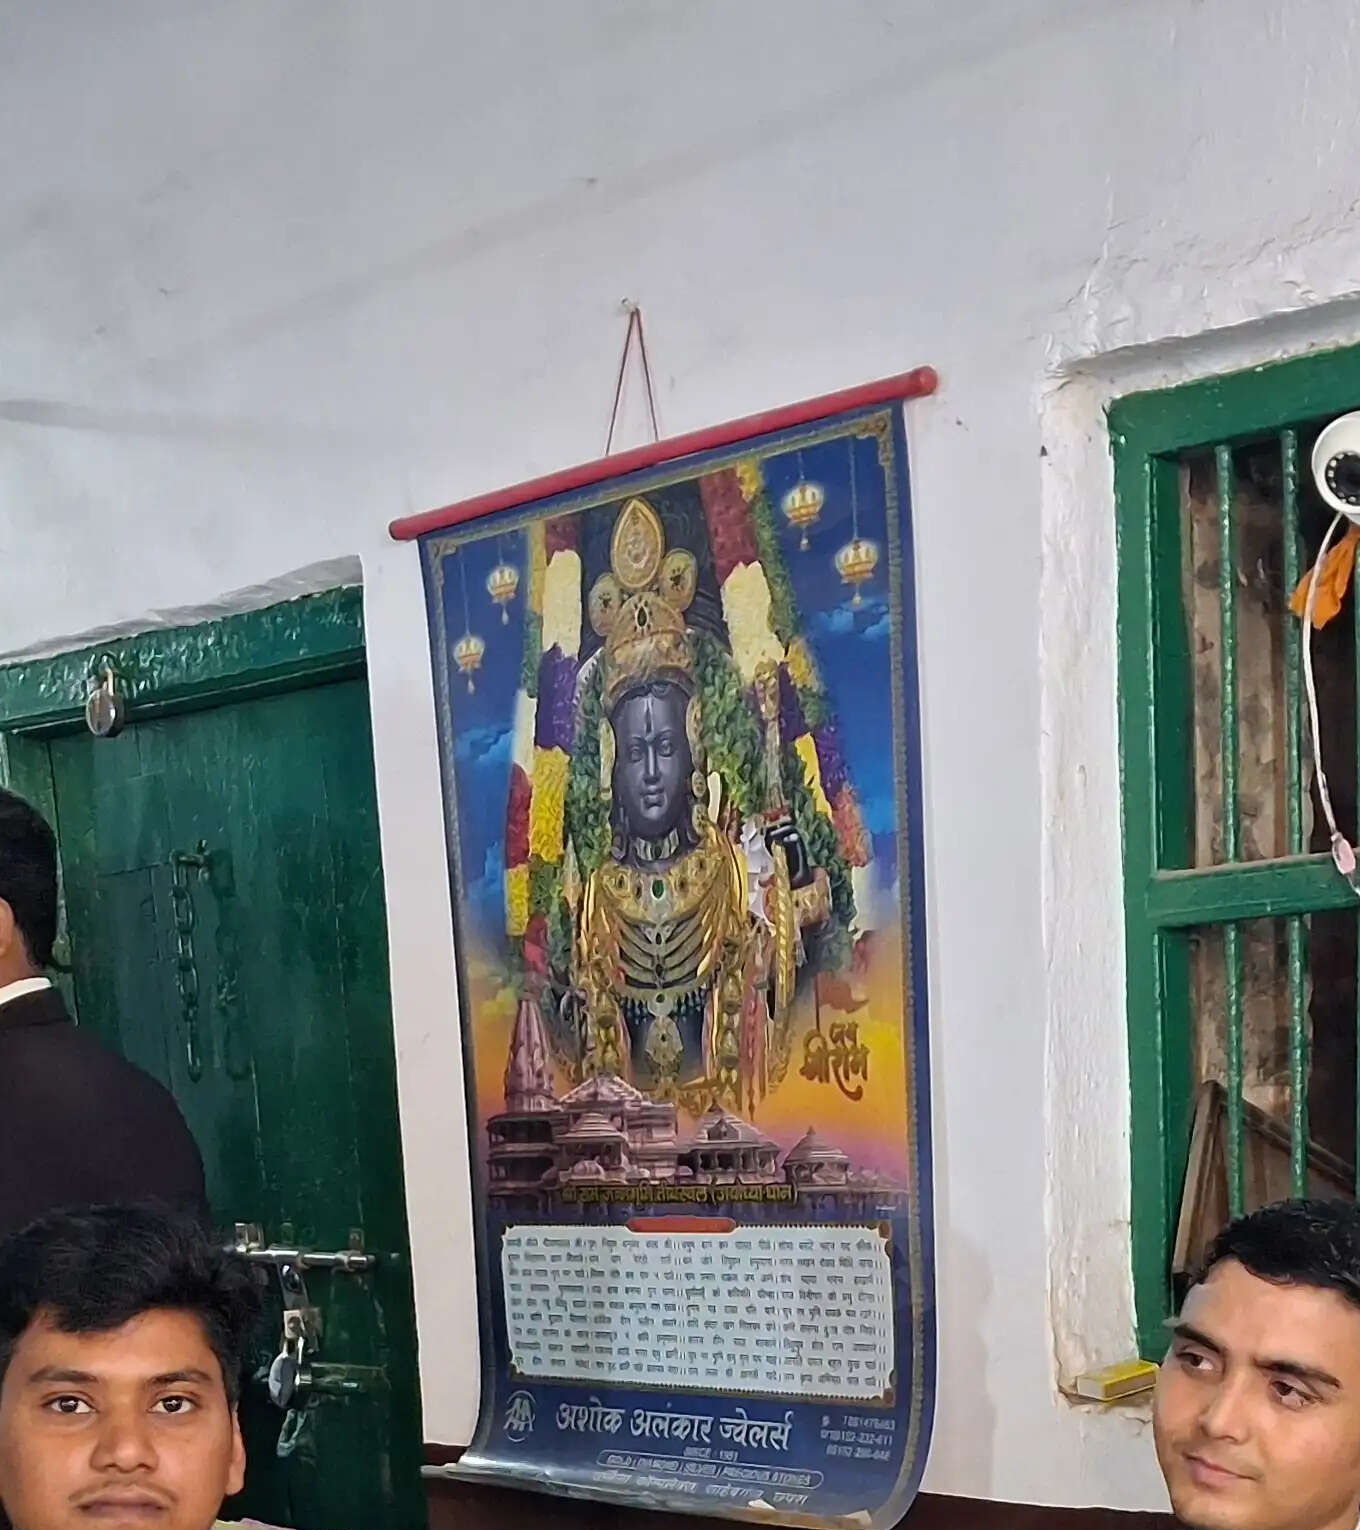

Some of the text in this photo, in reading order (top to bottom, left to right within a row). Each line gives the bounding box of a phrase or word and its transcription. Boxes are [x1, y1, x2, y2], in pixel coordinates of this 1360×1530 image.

[556, 1396, 625, 1434] अशोक
[630, 1402, 714, 1443] अलंकार
[719, 1408, 794, 1450] ज्वेलर्स
